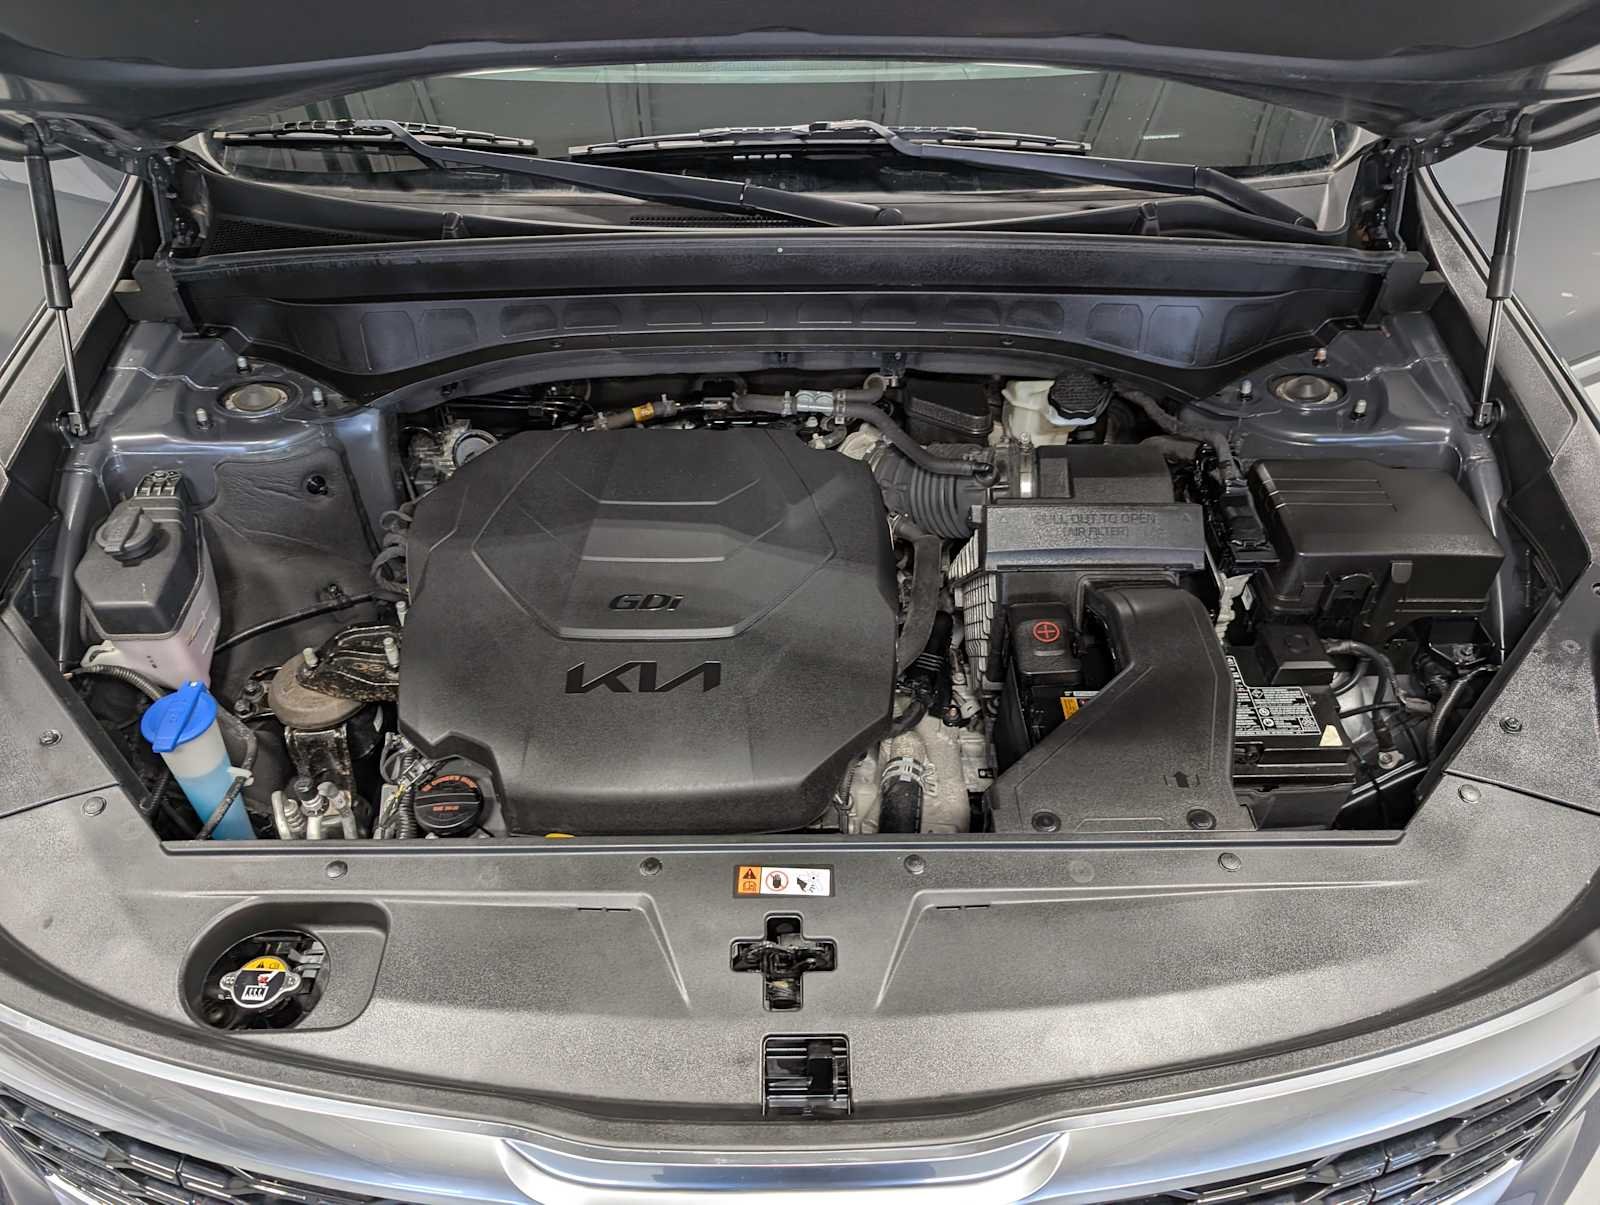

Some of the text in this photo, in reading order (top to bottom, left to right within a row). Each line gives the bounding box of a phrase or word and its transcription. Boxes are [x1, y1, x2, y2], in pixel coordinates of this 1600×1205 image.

[1070, 513, 1098, 525] OUT
[1099, 513, 1119, 525] TO
[1120, 513, 1157, 525] OPEN
[608, 593, 685, 612] GDi
[565, 660, 721, 693] KIA
